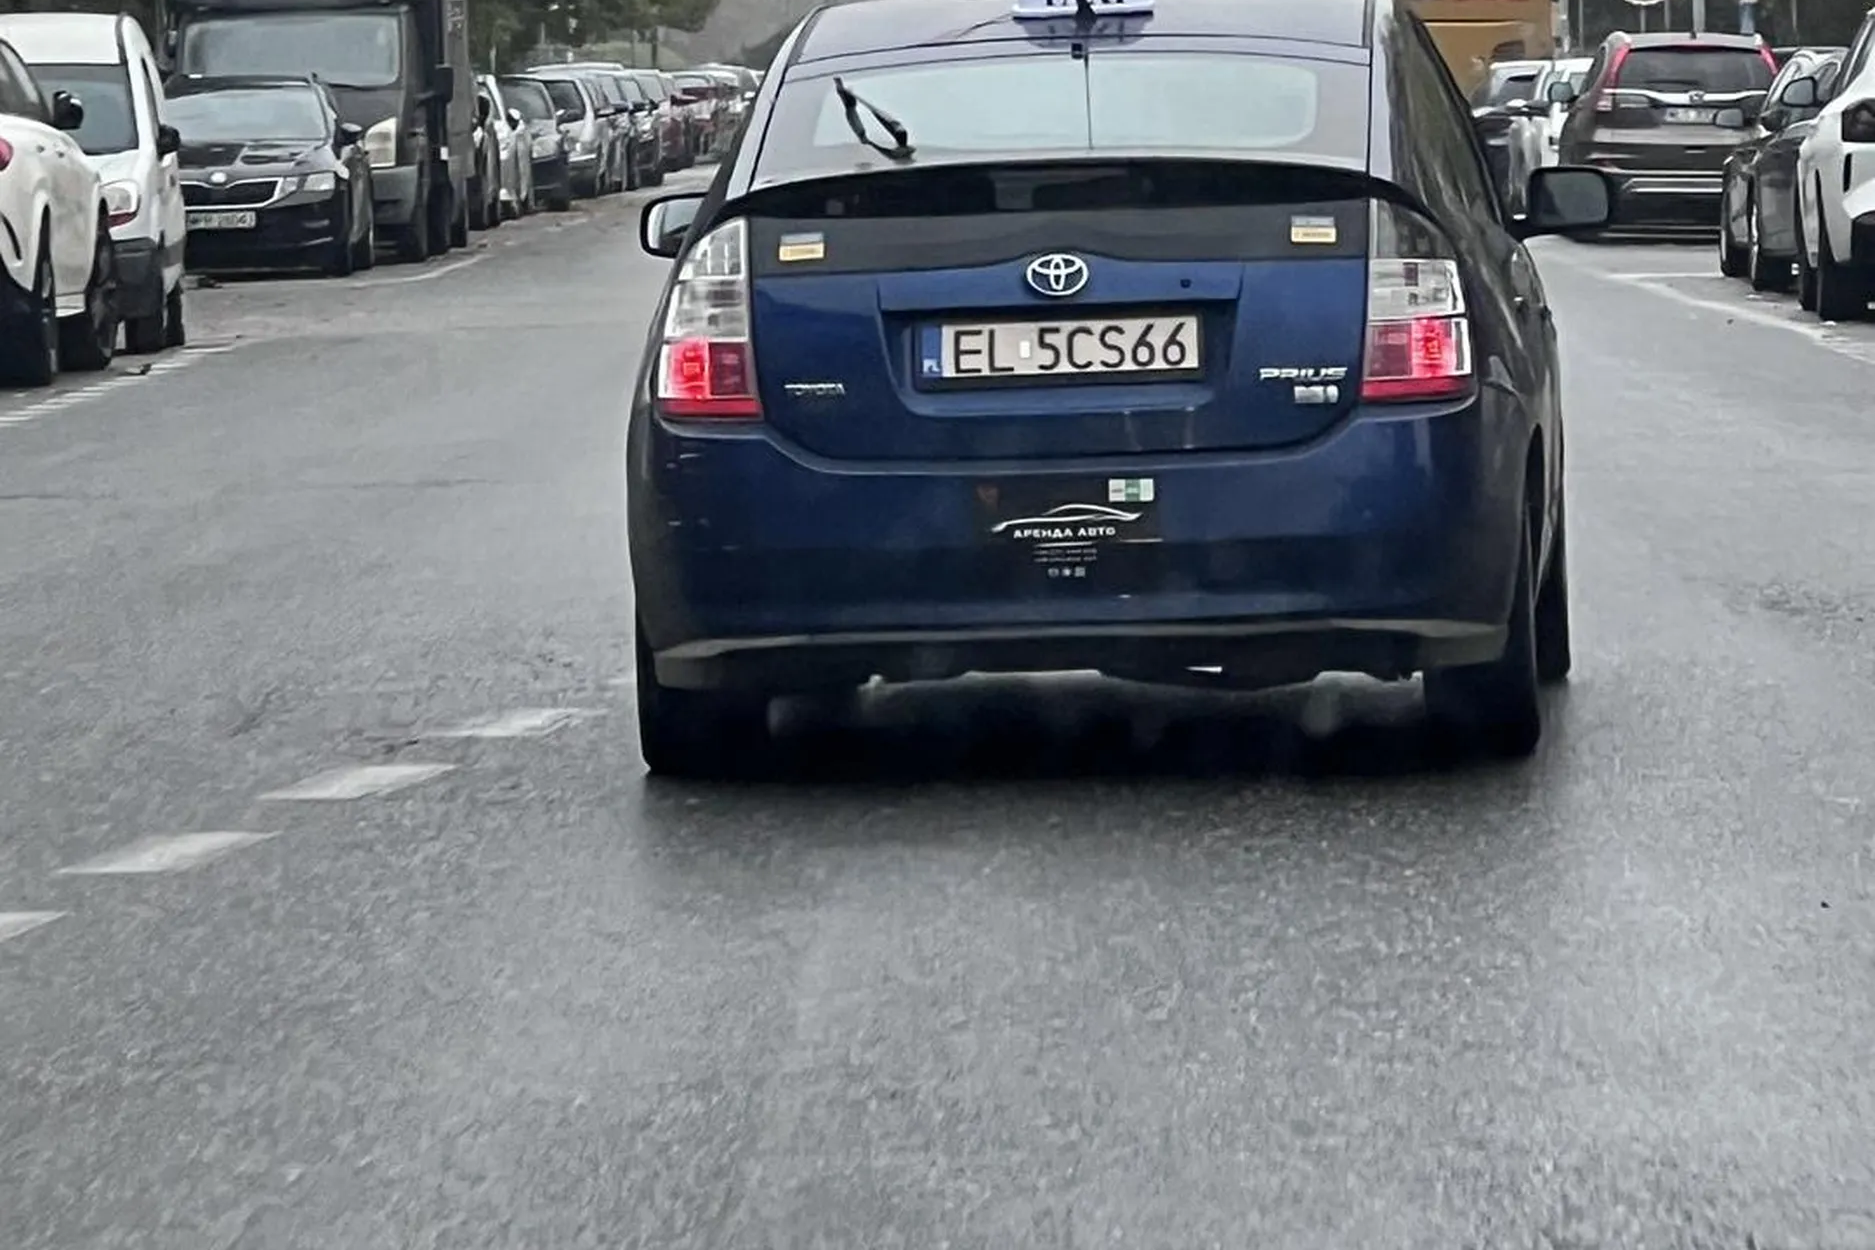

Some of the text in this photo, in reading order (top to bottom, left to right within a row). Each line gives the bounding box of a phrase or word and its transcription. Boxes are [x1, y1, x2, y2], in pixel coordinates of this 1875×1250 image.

[953, 321, 1187, 375] EL 5CS66
[1259, 366, 1348, 382] PRIUS
[1013, 527, 1073, 539] АРЕНДА
